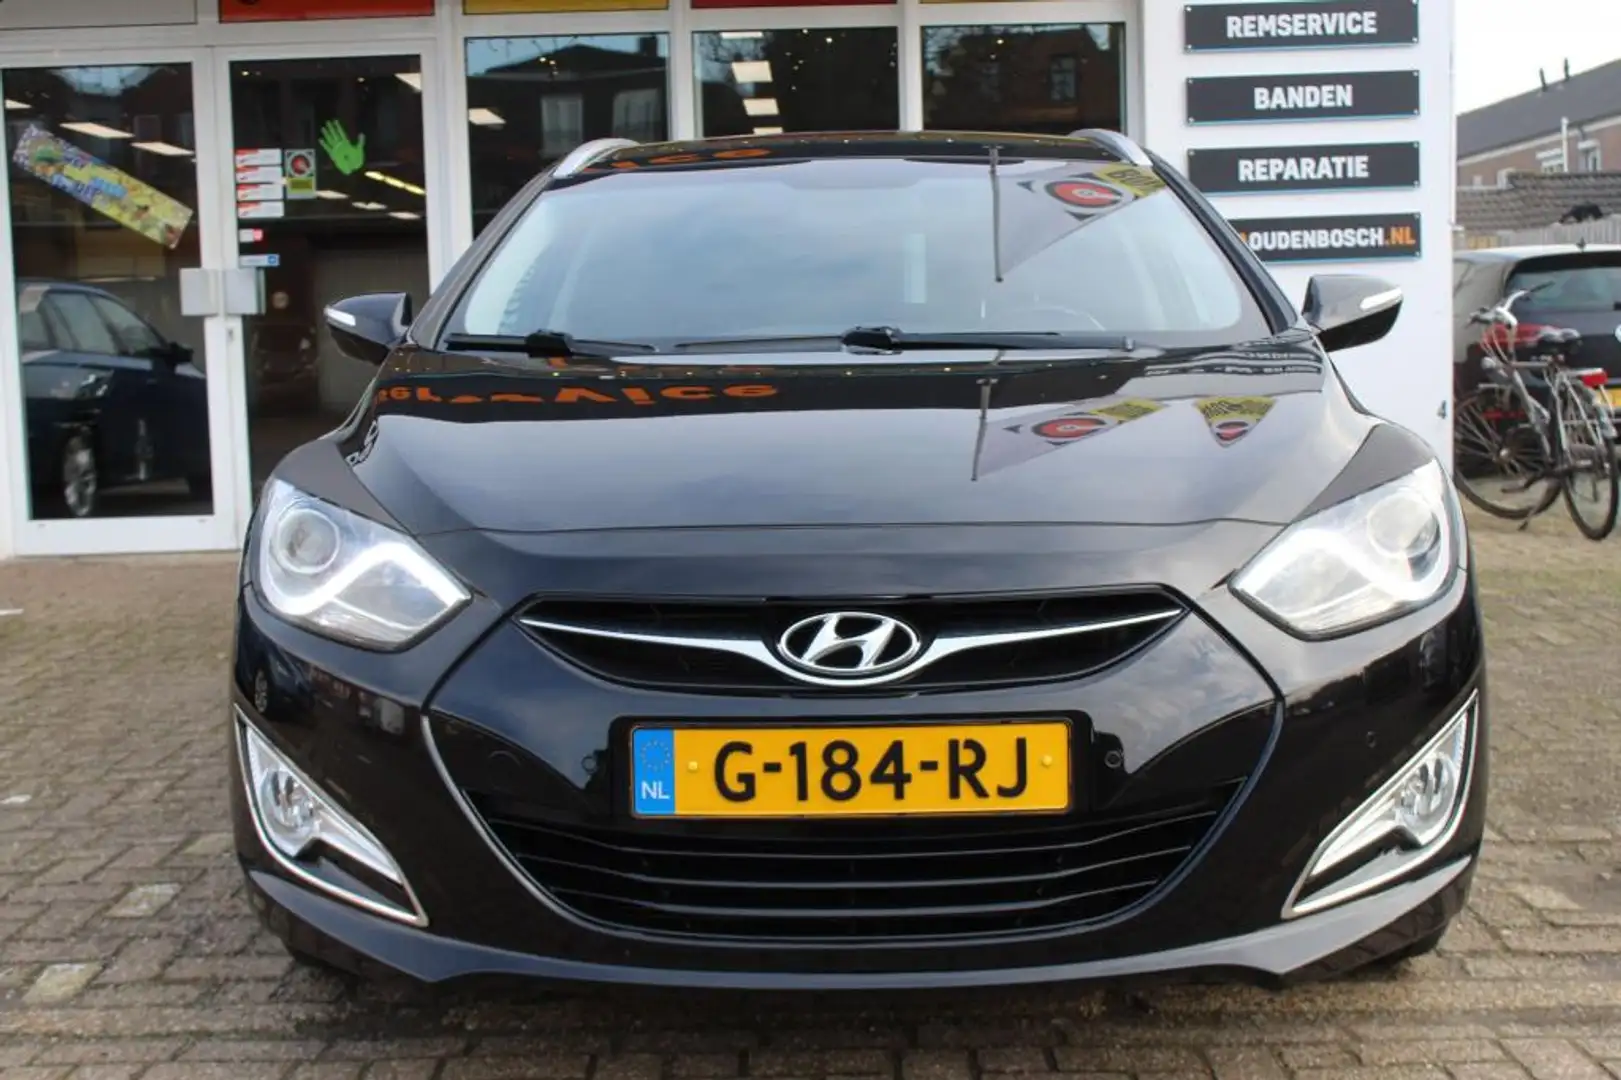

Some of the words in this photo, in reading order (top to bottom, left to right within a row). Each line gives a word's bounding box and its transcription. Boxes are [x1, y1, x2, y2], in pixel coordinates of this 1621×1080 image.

[1226, 11, 1378, 39] REMSERVICE
[1253, 84, 1354, 111] BANDEN
[1238, 155, 1370, 183] REPARATIE
[713, 736, 1029, 803] G-184-RJ
[641, 781, 670, 801] NL
